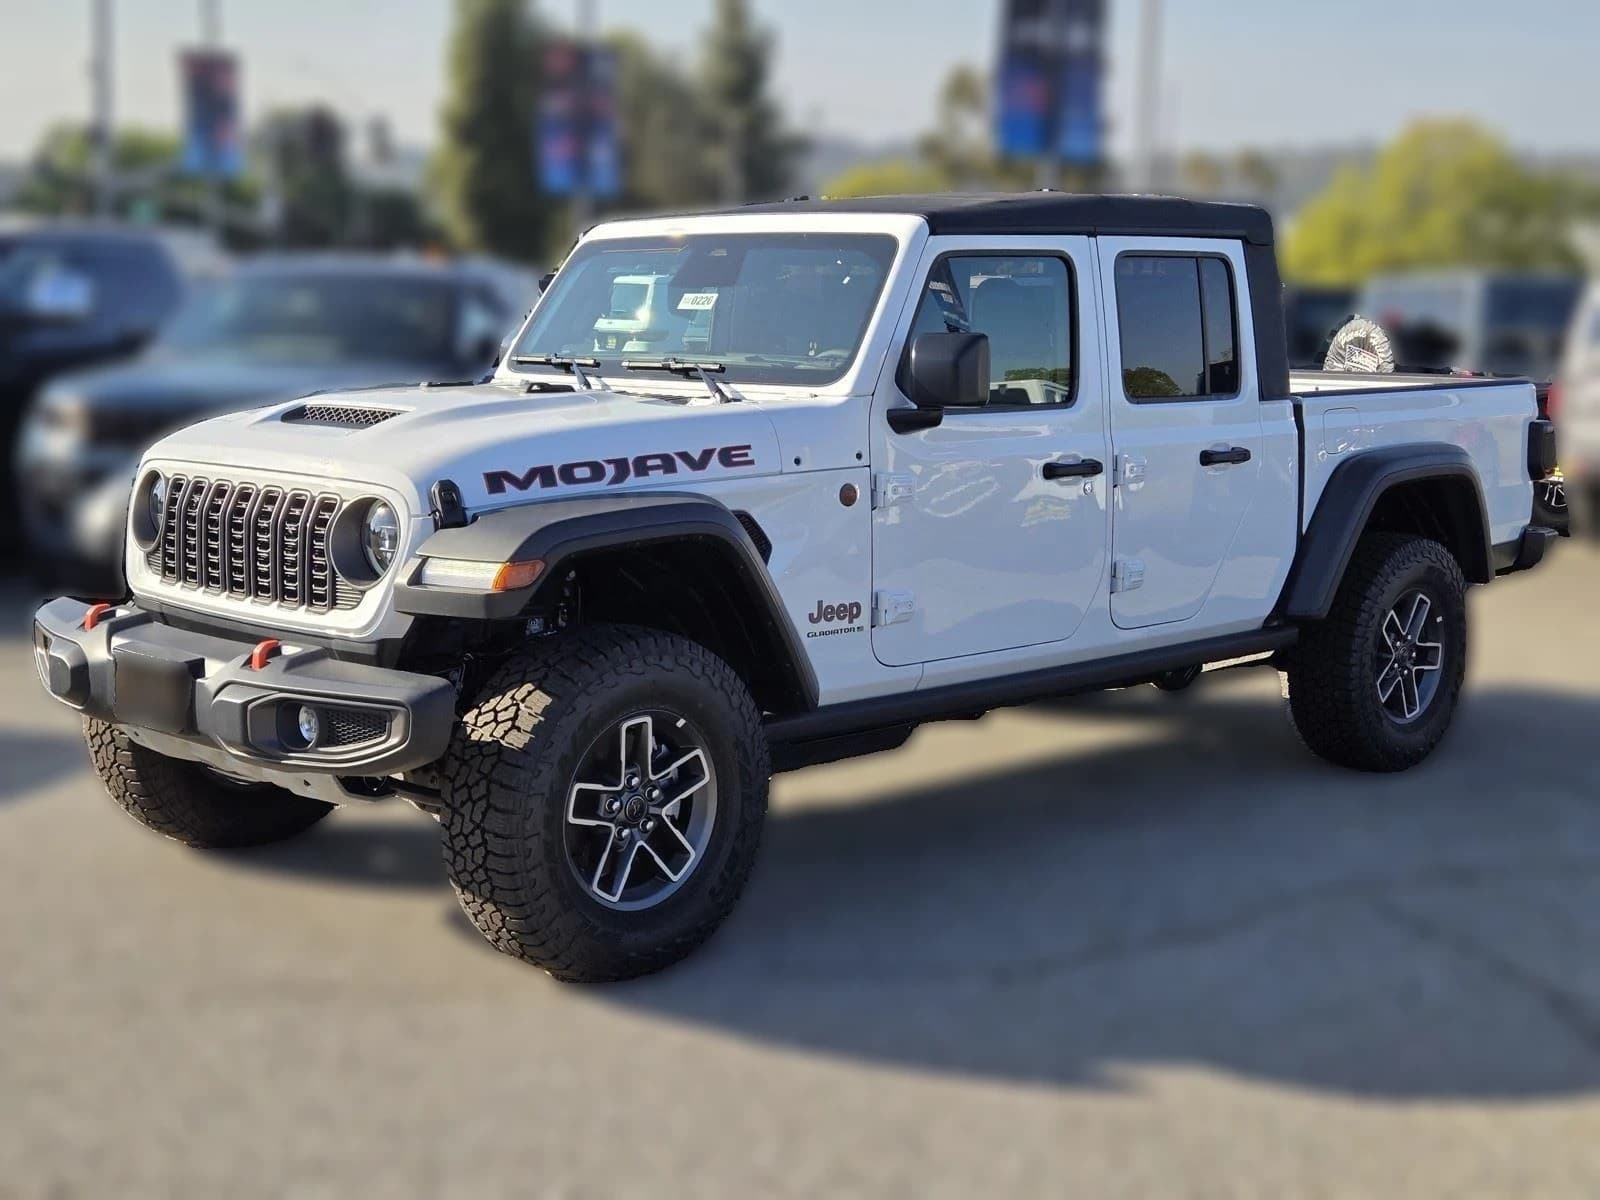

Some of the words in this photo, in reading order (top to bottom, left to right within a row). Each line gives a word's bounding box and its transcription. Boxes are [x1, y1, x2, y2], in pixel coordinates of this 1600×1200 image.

[482, 444, 755, 495] MOJAVE
[808, 600, 862, 624] Jeep
[807, 627, 856, 638] GLADIATOR
